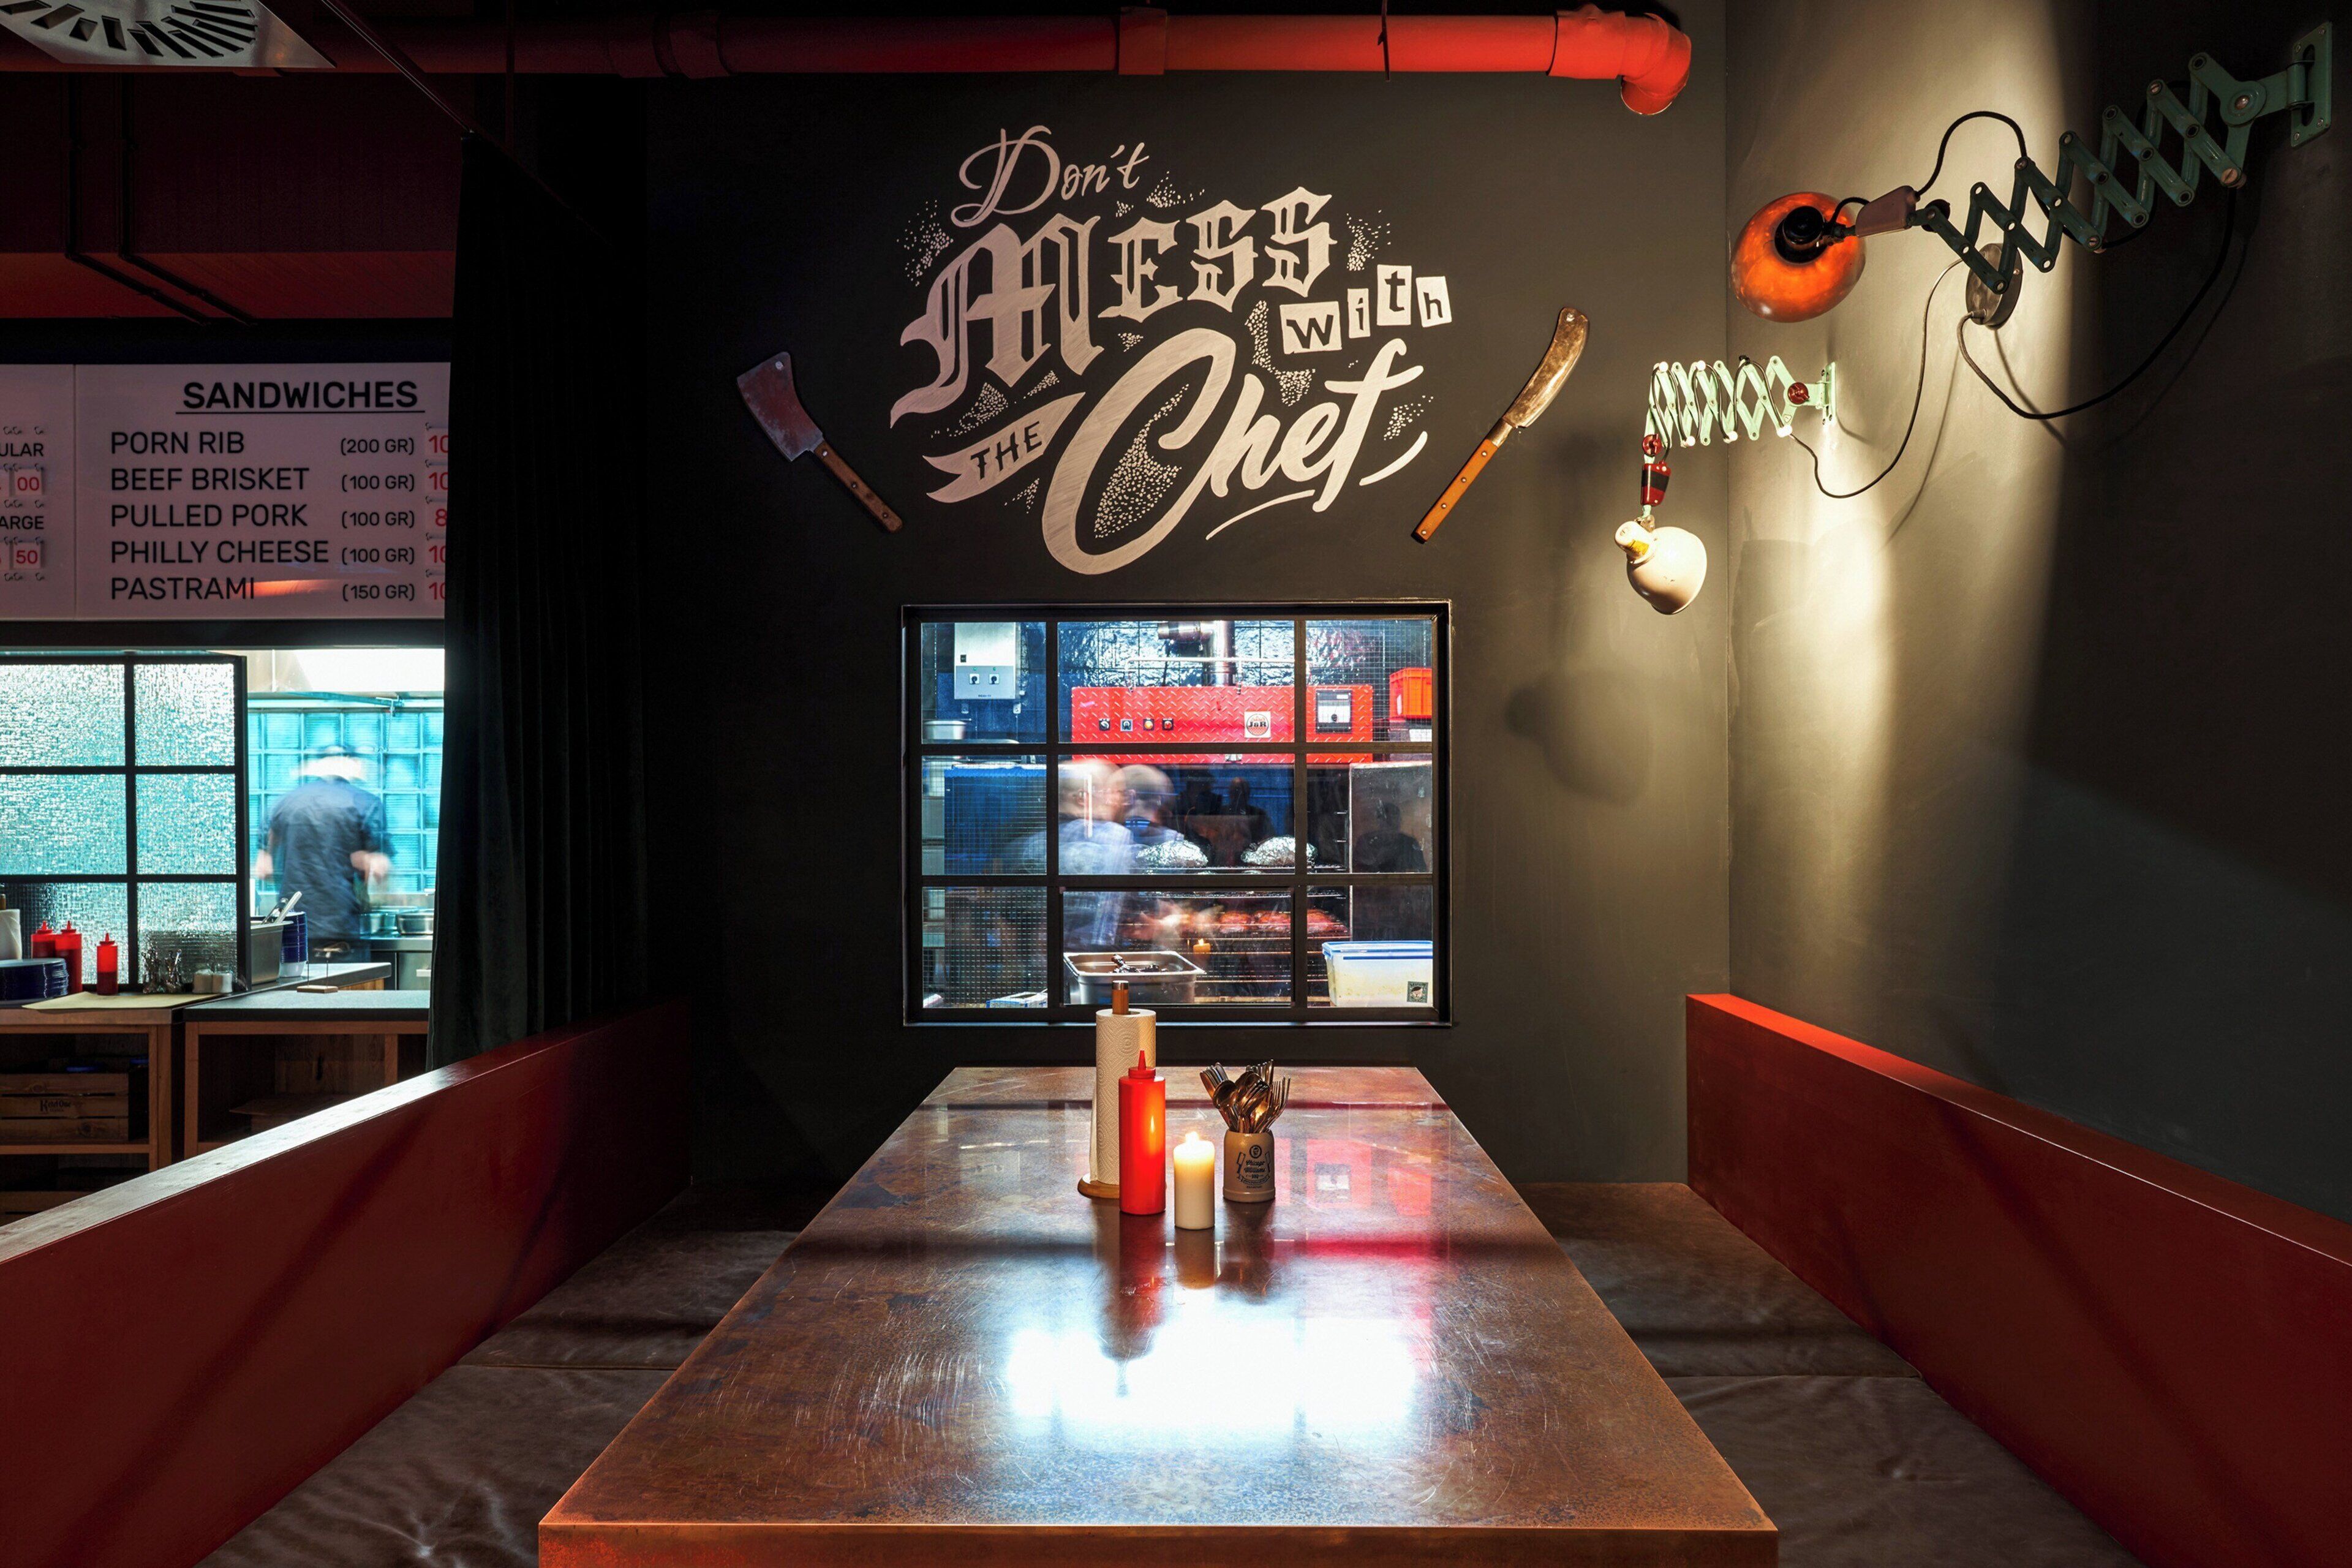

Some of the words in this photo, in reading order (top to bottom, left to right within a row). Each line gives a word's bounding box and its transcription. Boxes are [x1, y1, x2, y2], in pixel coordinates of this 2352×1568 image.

[950, 125, 1150, 228] Don't
[1284, 268, 1444, 350] with
[183, 380, 418, 409] SANDWICHES
[111, 431, 189, 454] PORN
[199, 431, 245, 454] RIB
[340, 437, 380, 456] (200
[385, 437, 415, 456] GR)
[970, 418, 1044, 480] THE
[1041, 327, 1426, 575] Chef
[17, 477, 40, 491] 00
[111, 467, 183, 491] BEEF
[192, 467, 310, 491] BRISKET
[341, 474, 380, 492] (100
[385, 473, 415, 492] GR)
[111, 504, 222, 527] PULLED
[232, 503, 308, 527] PORK
[341, 511, 380, 529] (100
[385, 510, 415, 529] GR)
[15, 549, 39, 564] 50
[111, 540, 209, 564] PHILLY
[217, 540, 329, 564] CHEESE
[341, 547, 380, 566] (100
[385, 546, 415, 565] GR)
[111, 576, 255, 600] PASTRAMI
[342, 584, 380, 602] (150
[385, 583, 415, 601] GR)
